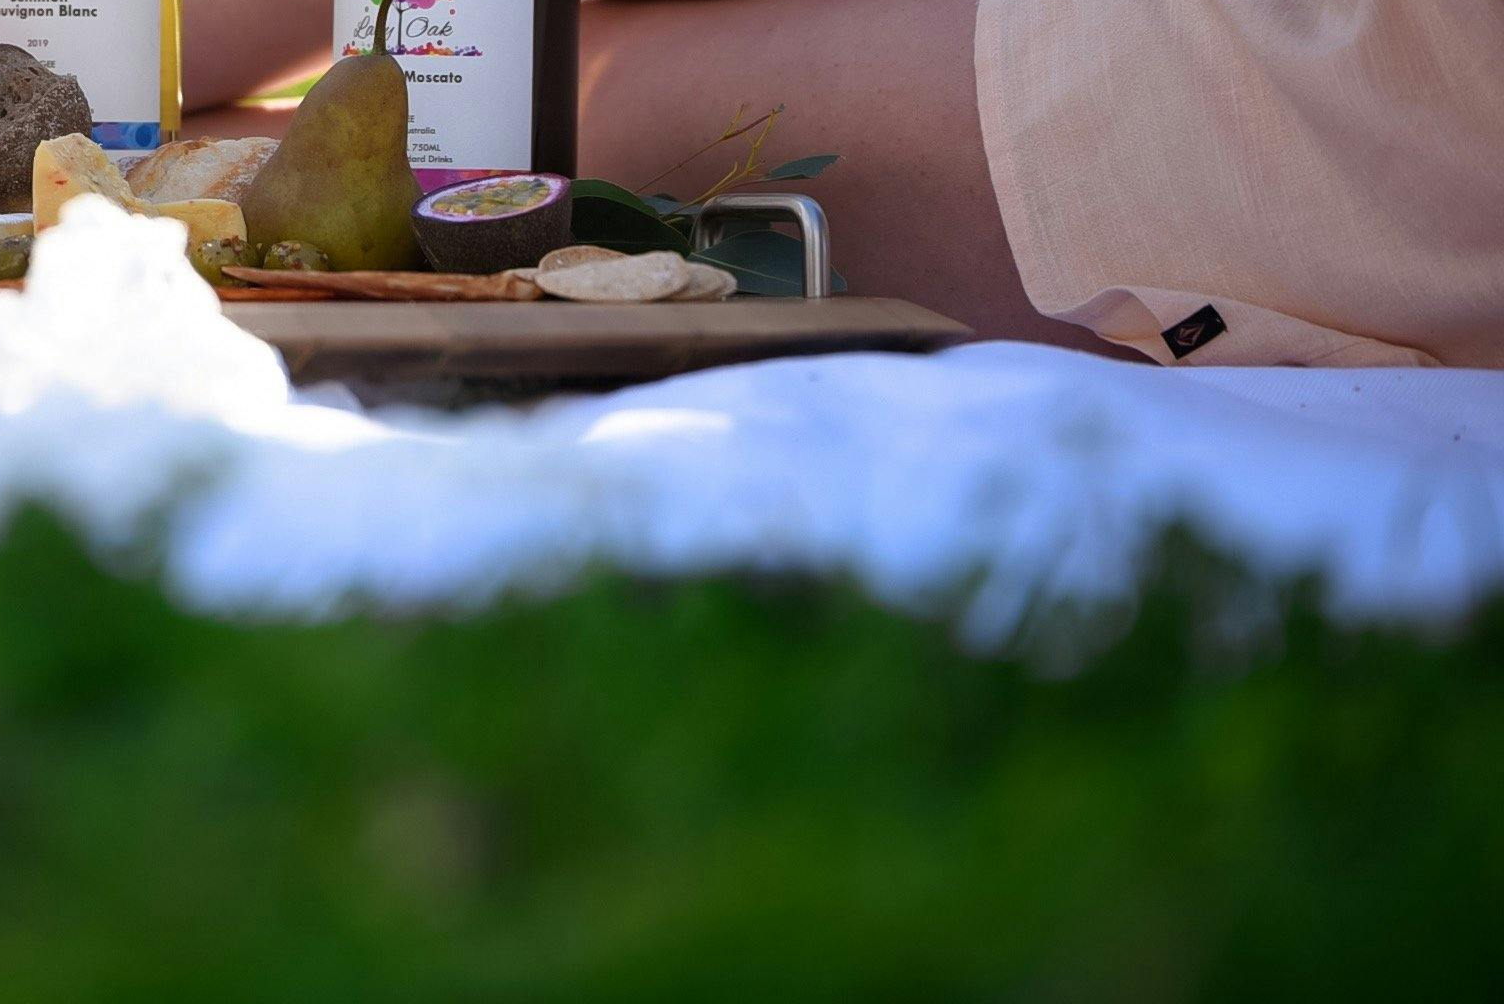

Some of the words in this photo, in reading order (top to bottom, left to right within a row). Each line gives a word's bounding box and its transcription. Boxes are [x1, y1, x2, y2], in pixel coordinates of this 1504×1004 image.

[59, 4, 98, 18] Blanc
[354, 15, 395, 41] Lay
[406, 16, 454, 38] Oak
[27, 39, 49, 48] 2019
[405, 70, 463, 84] Moscato
[408, 127, 436, 135] ustralia
[412, 143, 441, 152] 750ML
[428, 155, 454, 163] Drinks
